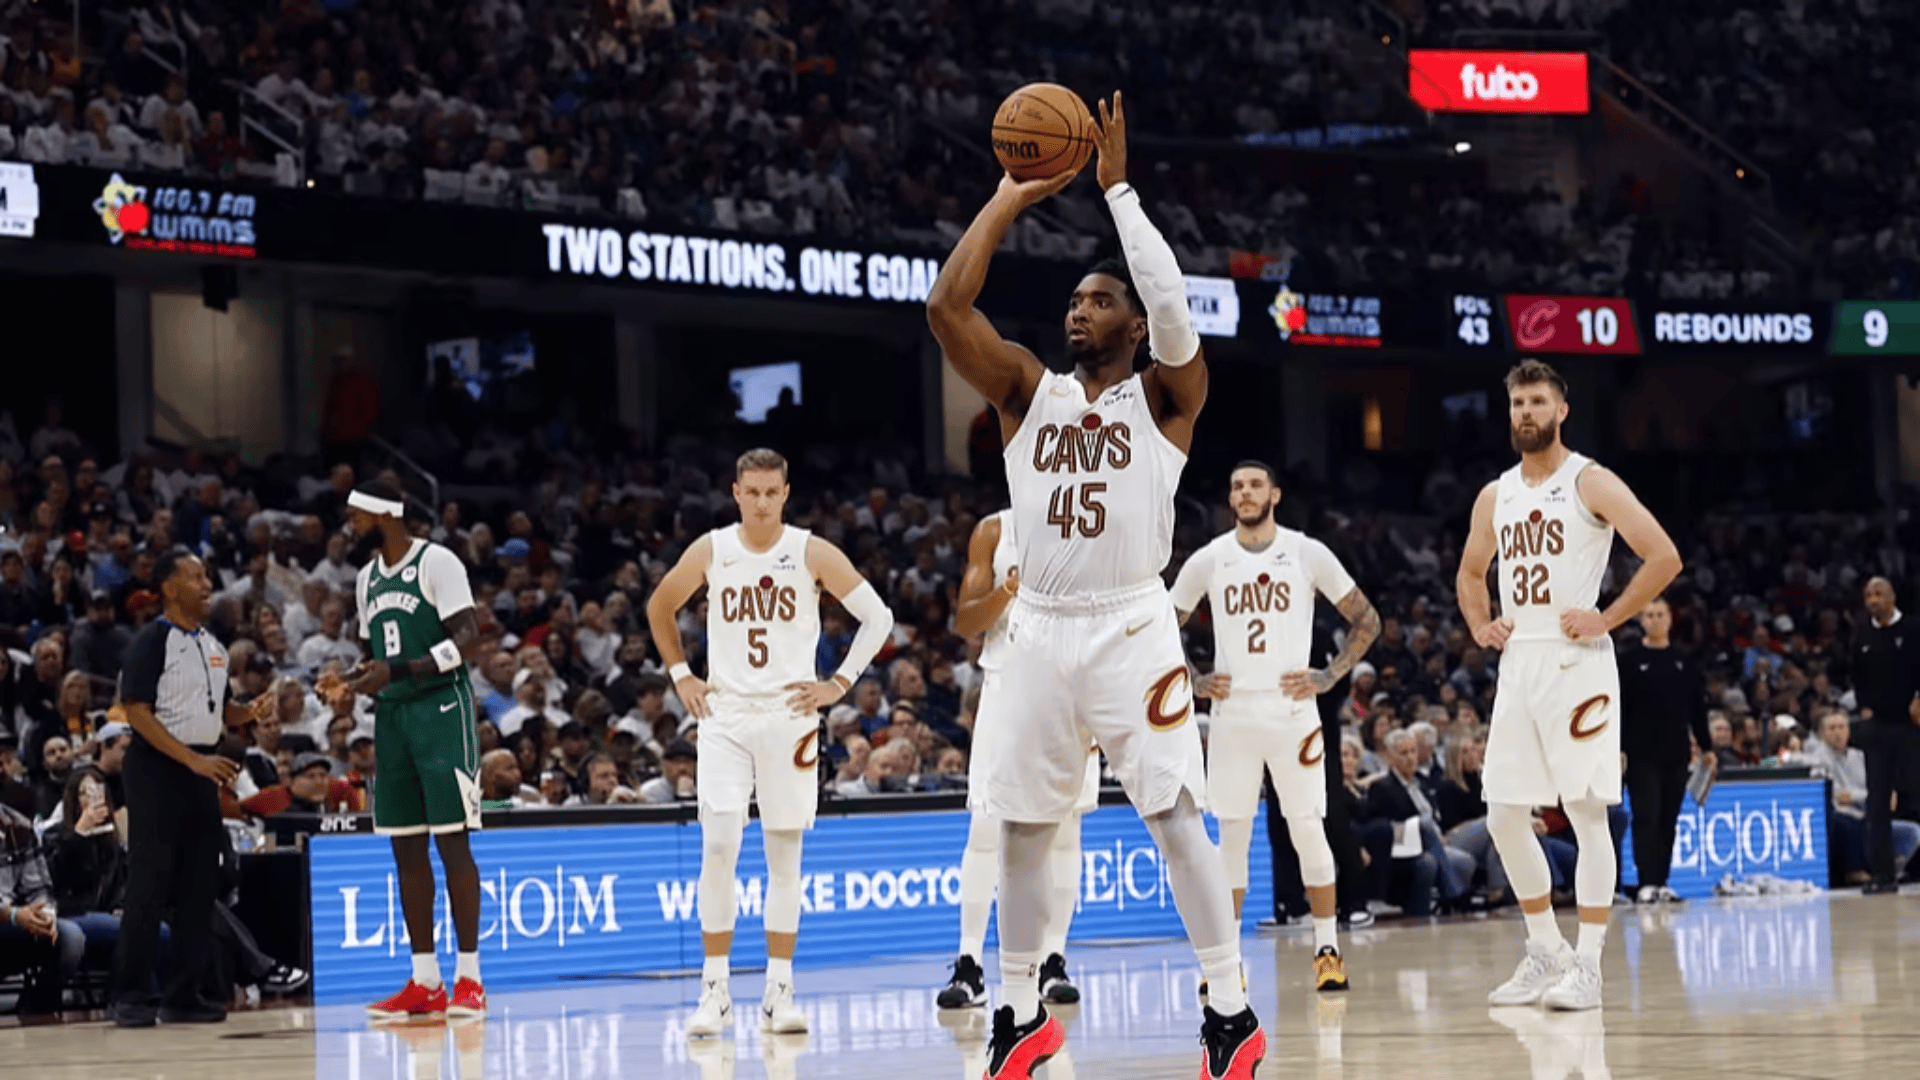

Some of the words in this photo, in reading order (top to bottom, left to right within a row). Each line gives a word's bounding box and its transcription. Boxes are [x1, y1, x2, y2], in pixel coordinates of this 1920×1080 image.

[1459, 63, 1539, 100] fubo
[152, 187, 212, 213] 100.7
[542, 224, 623, 277] TWO
[628, 231, 796, 292] STATIONS.
[800, 247, 864, 297] ONE
[1458, 316, 1490, 345] 43
[1576, 307, 1618, 346] 10
[1655, 312, 1813, 343] REBOUNDS
[1863, 309, 1888, 347] 9
[1033, 422, 1132, 474] CAVS
[1047, 482, 1108, 539] 45
[1501, 518, 1565, 561] CAVS
[721, 585, 796, 623] CAVS
[1224, 581, 1291, 616] CAVS
[1512, 563, 1552, 607] 32
[747, 627, 769, 669] 5
[1247, 618, 1267, 655] 2
[656, 880, 700, 921] W
[734, 872, 835, 918] MKE
[845, 867, 962, 911] DOCTO
